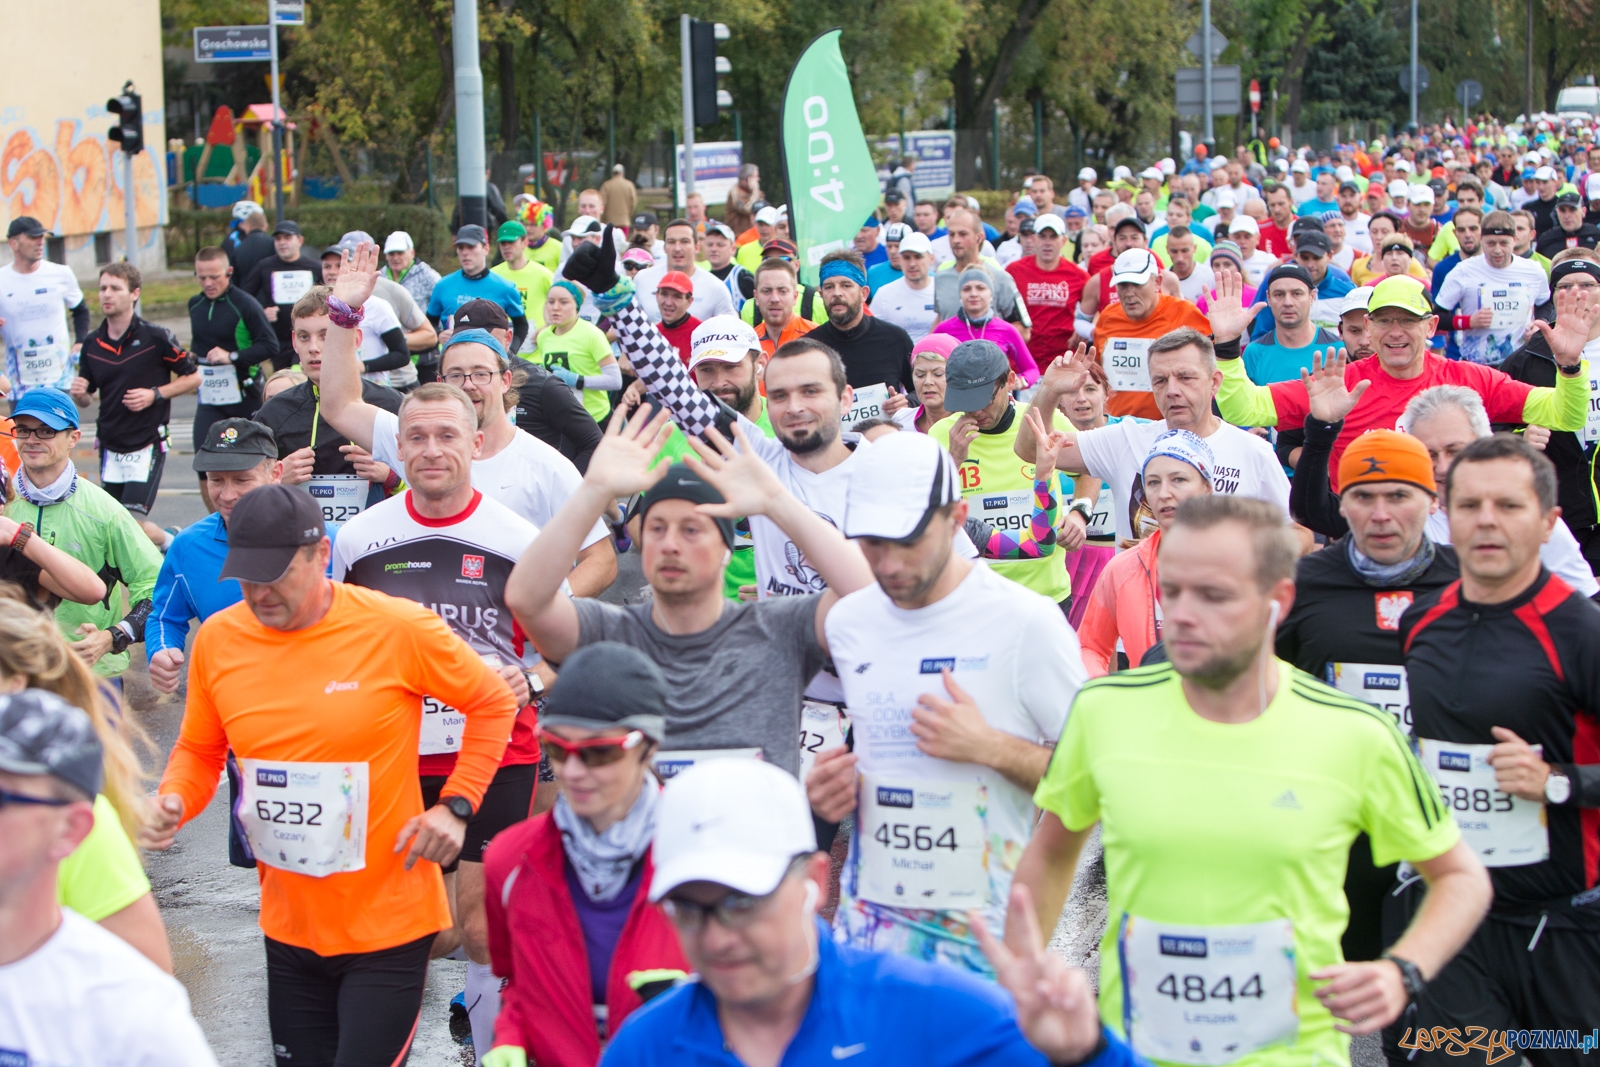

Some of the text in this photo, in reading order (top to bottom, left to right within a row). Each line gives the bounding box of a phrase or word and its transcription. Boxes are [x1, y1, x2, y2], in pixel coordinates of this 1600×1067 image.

[200, 38, 268, 51] Grochowska
[803, 95, 845, 212] 4:00
[1027, 289, 1070, 300] SZPIKU
[1493, 301, 1519, 311] 1032
[25, 358, 52, 369] 2680
[1112, 355, 1141, 368] 5201
[203, 378, 229, 388] 4899
[841, 404, 880, 422] 4768
[1214, 476, 1239, 495] ÓW
[985, 499, 1007, 508] 17.PKO
[385, 560, 432, 572] promohouse
[335, 681, 359, 691] asics
[1366, 675, 1399, 687] 17.PKO
[258, 771, 286, 784] 17.PKO
[256, 800, 322, 827] 6232
[273, 828, 305, 843] Cezary
[875, 823, 958, 852] 4564
[892, 857, 935, 871] Michał
[1156, 972, 1265, 1003] 4844
[1183, 1011, 1239, 1024] Leszek
